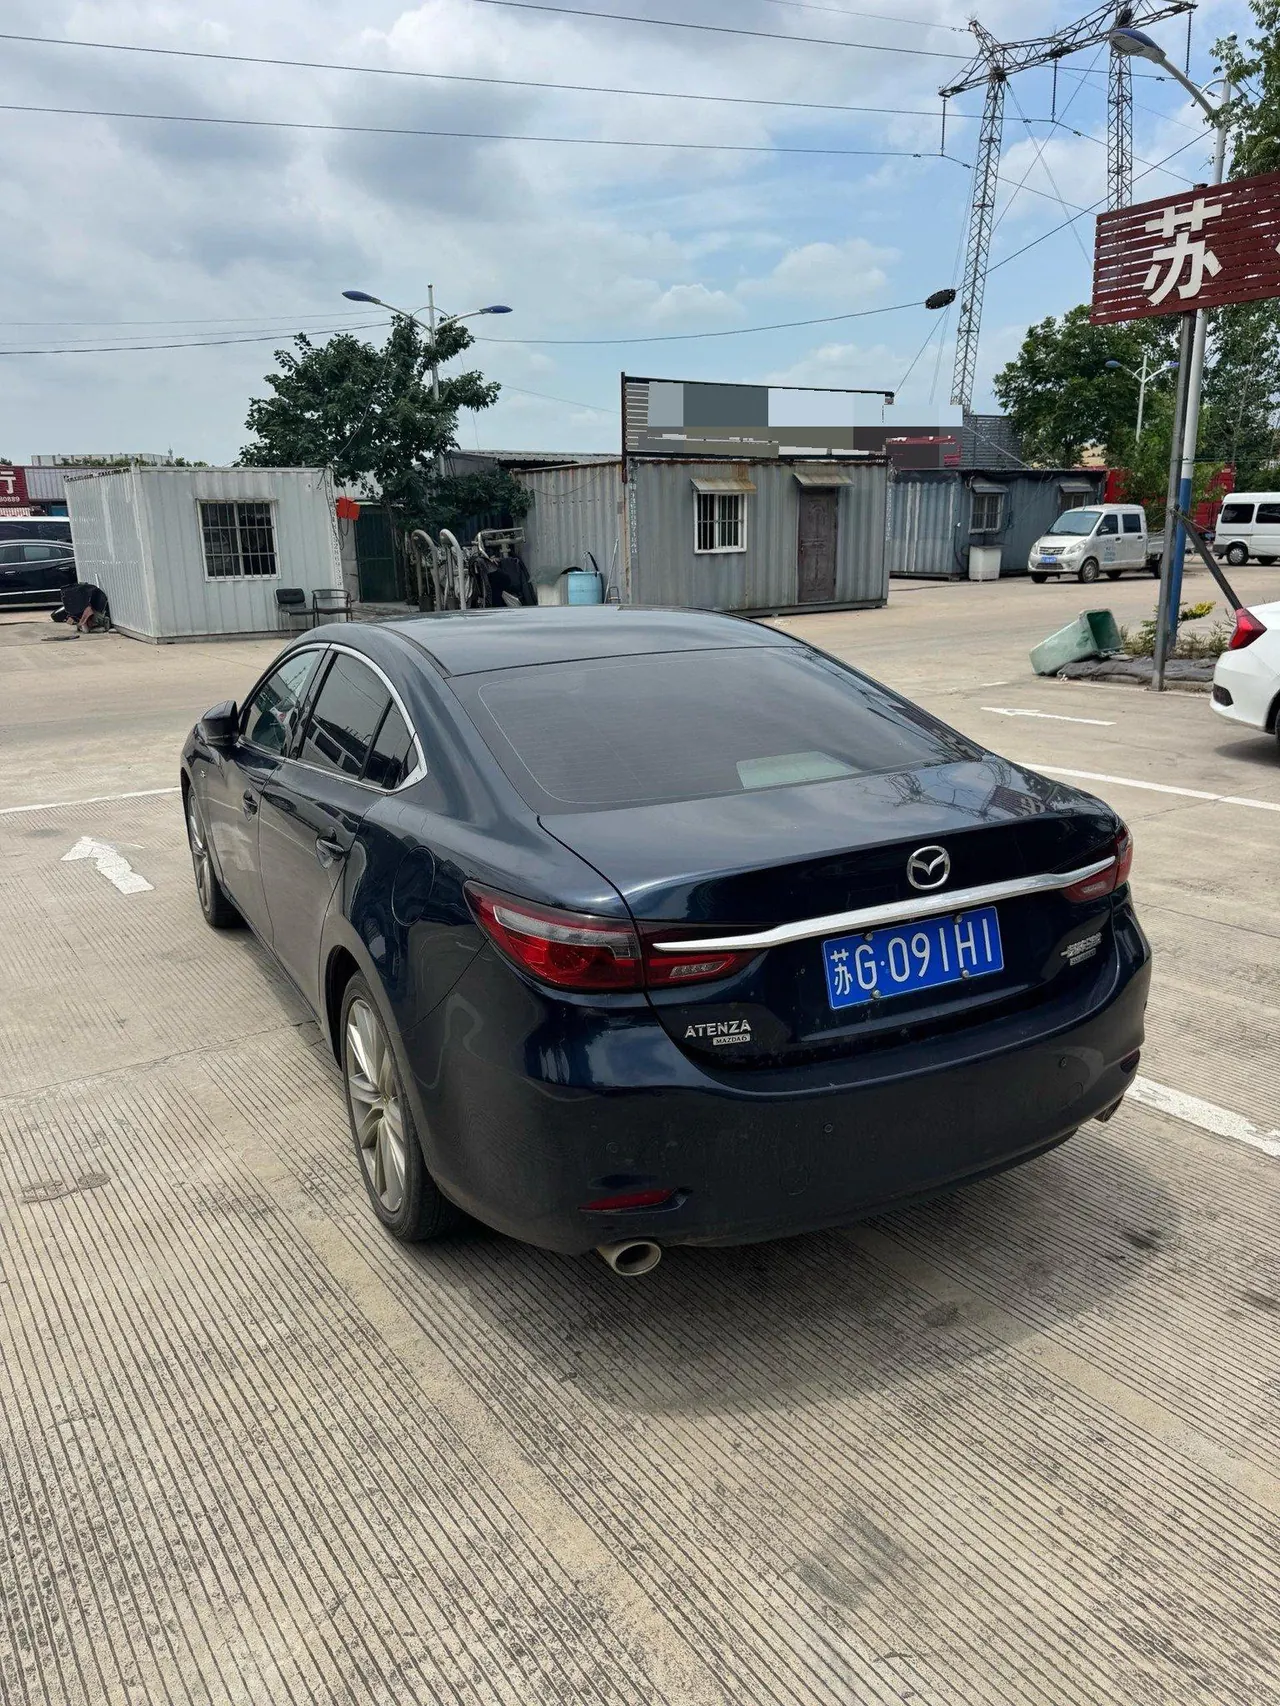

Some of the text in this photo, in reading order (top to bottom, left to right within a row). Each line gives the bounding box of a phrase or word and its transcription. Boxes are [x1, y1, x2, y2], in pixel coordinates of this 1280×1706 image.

[1142, 197, 1280, 306] 苏
[684, 1019, 752, 1039] ATENZA
[715, 1034, 749, 1044] MAZDA6
